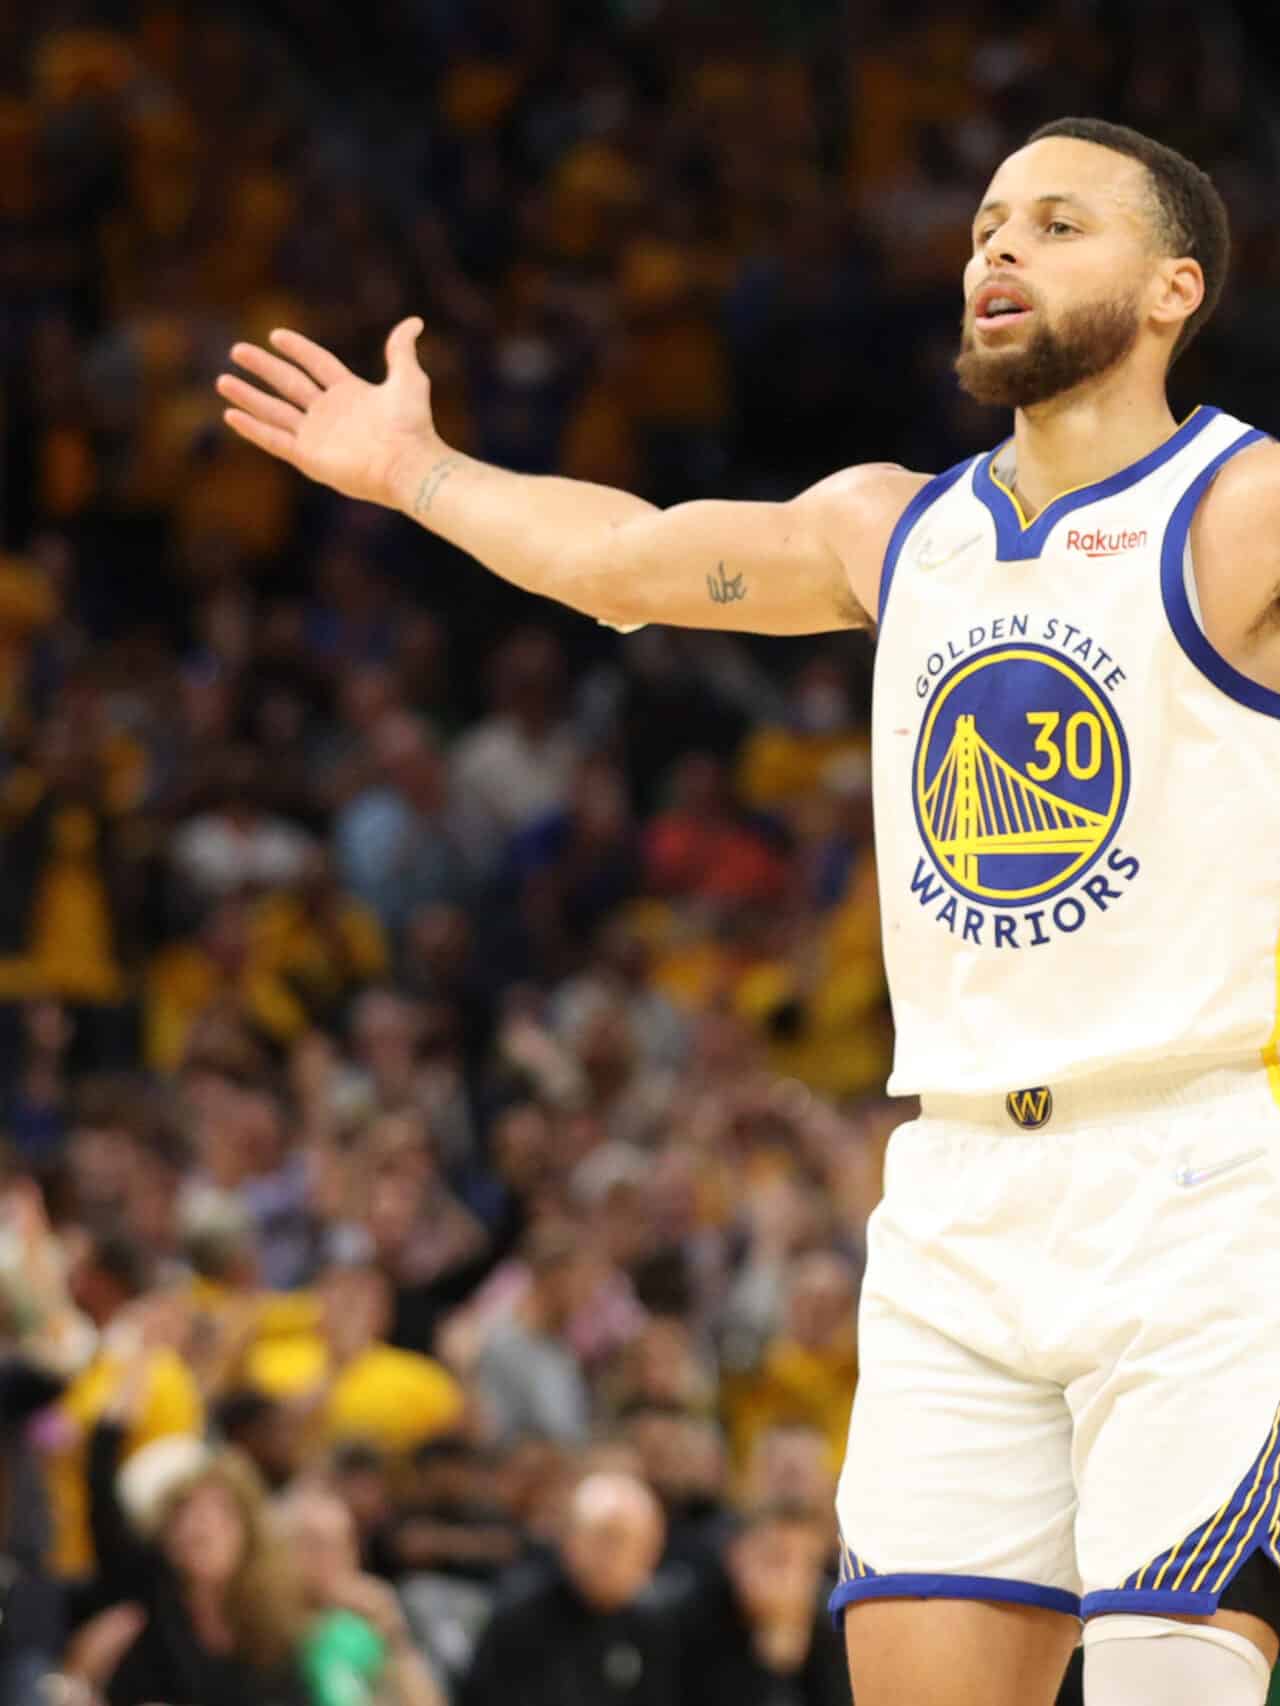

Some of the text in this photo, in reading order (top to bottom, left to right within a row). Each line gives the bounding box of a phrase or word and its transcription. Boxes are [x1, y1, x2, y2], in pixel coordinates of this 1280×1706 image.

[1066, 528, 1147, 551] Rakuten
[915, 614, 1128, 699] GOLDEN STATE
[1025, 711, 1103, 782] 30
[909, 847, 1141, 948] WARRIORS
[1009, 1090, 1049, 1122] W
